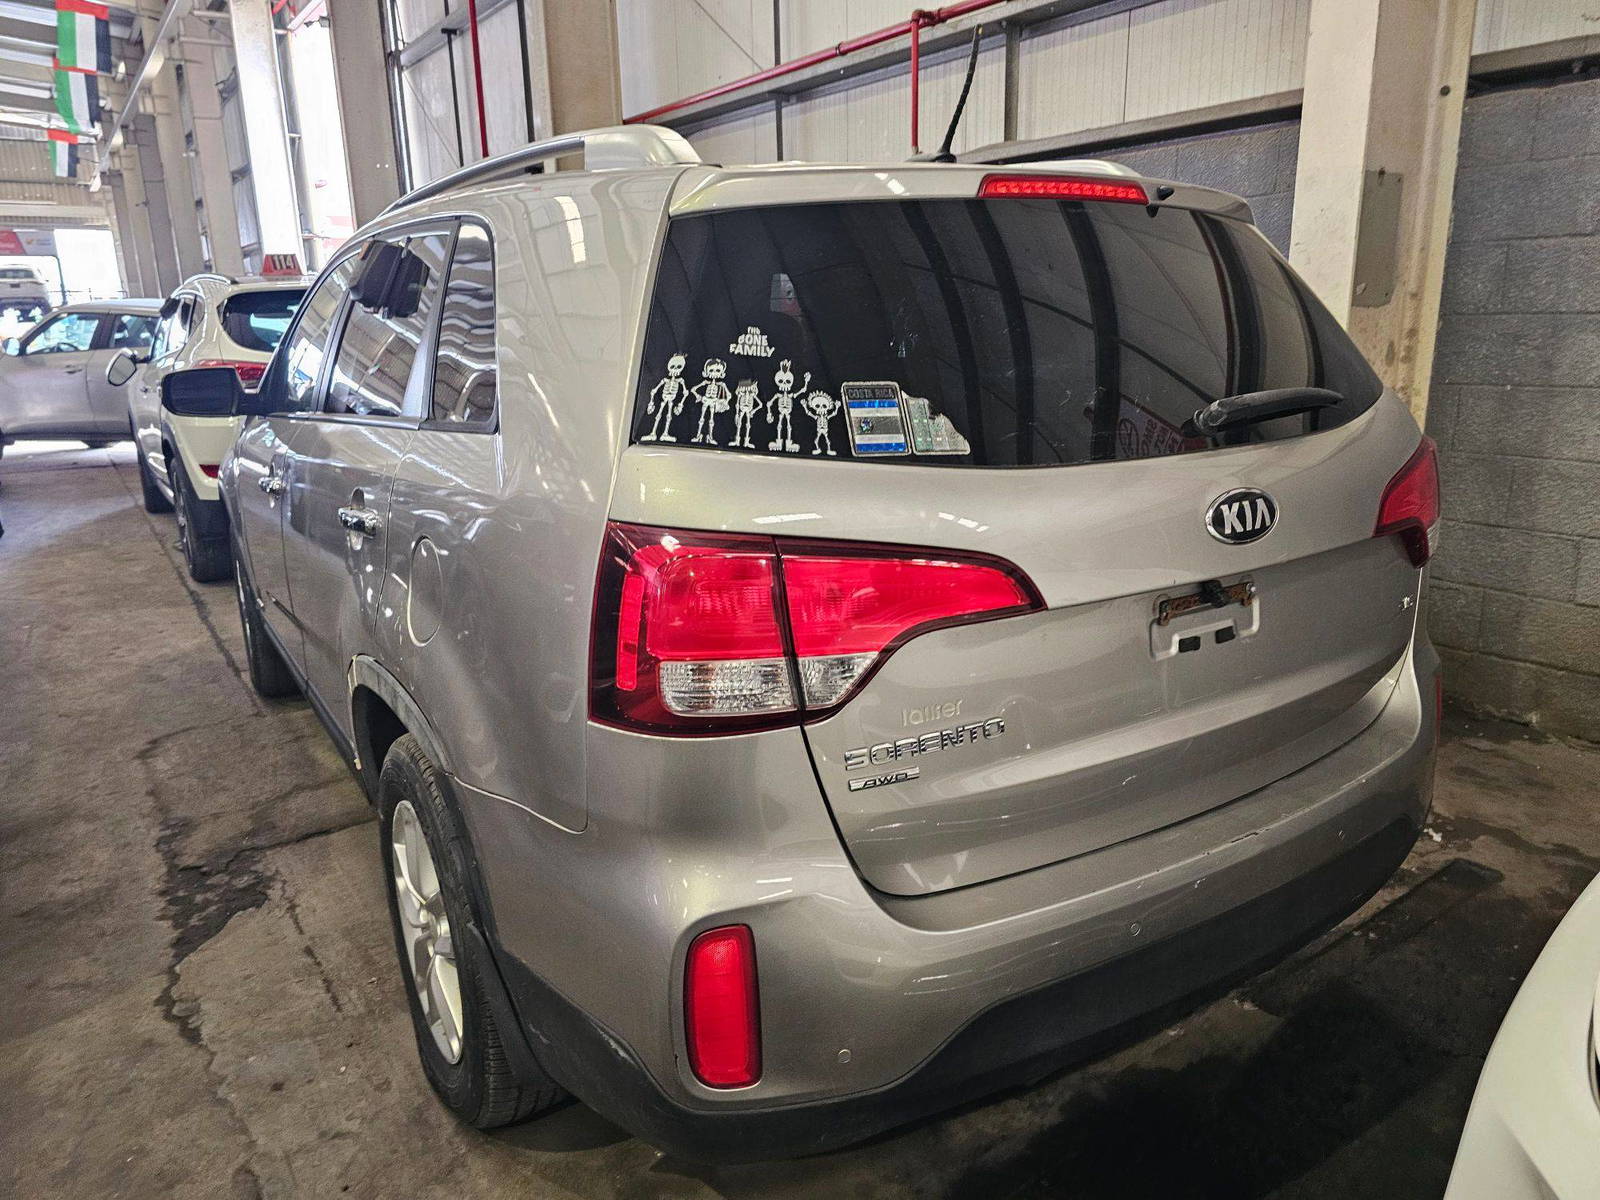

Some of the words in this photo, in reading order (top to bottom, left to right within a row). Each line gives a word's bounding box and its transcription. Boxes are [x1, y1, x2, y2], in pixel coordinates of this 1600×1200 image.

[738, 334, 768, 346] BONE
[730, 343, 775, 358] FAMILY
[848, 388, 873, 399] COSTA
[875, 388, 895, 399] RICA
[1219, 498, 1272, 535] KIA
[844, 716, 1005, 771] SORENTO
[862, 772, 908, 789] AWD
